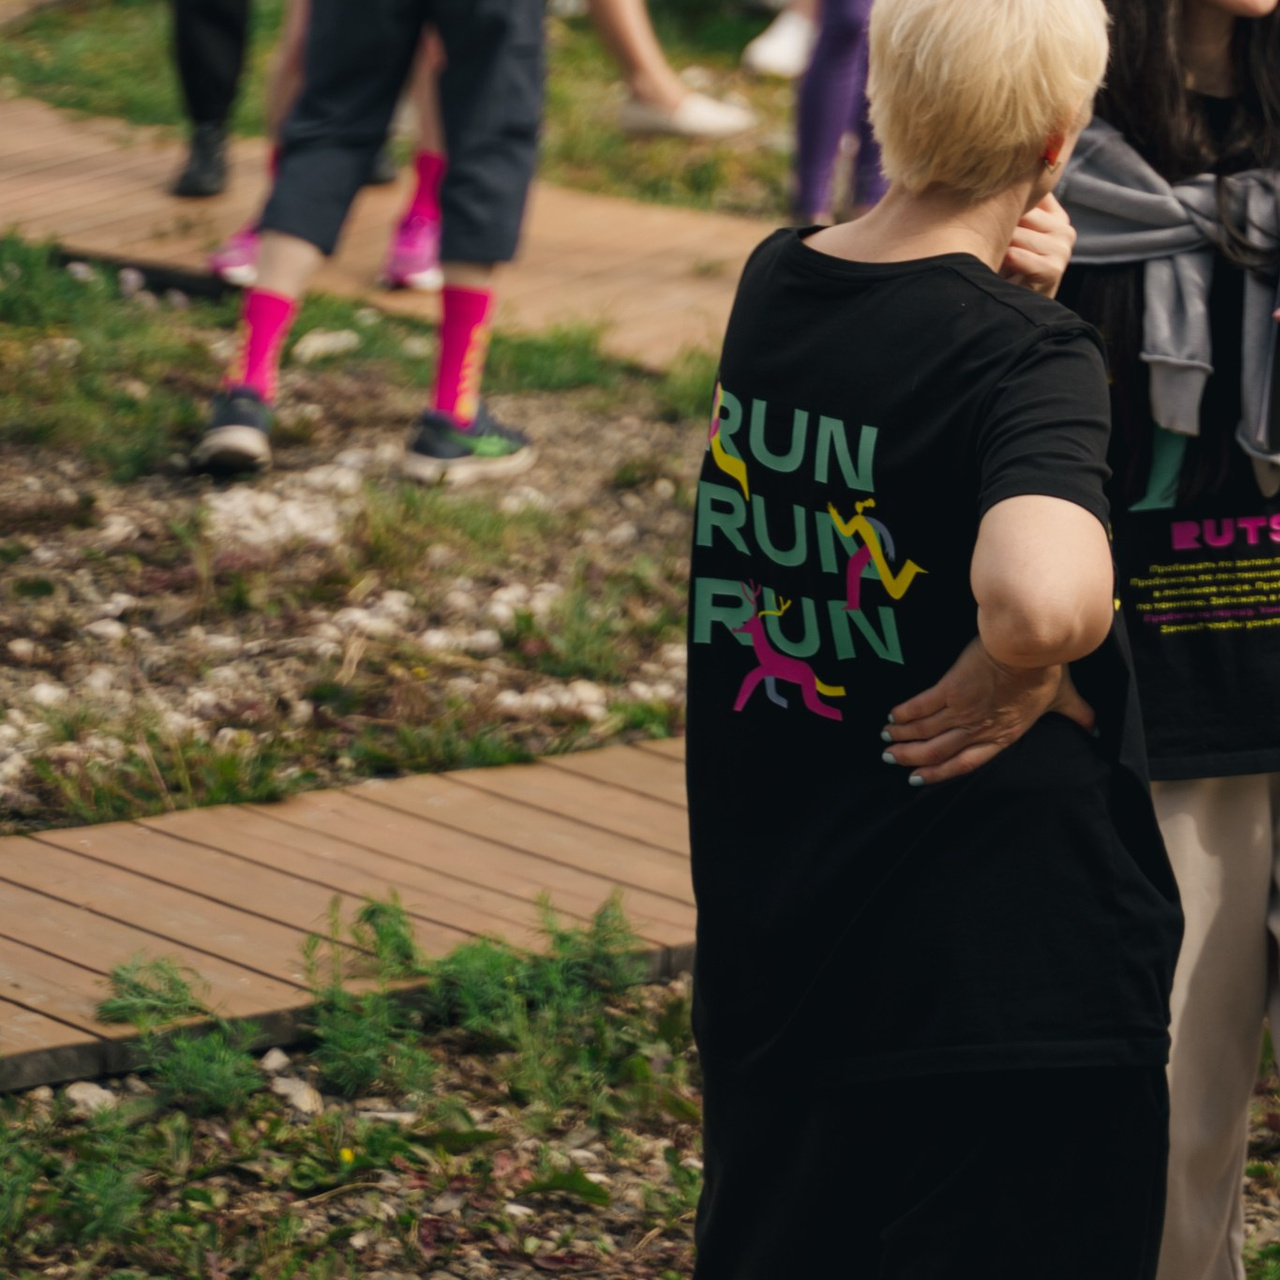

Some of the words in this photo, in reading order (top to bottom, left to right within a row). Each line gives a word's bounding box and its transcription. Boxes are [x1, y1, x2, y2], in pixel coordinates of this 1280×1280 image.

[706, 390, 879, 493] RUN
[696, 480, 883, 580] RUN
[693, 577, 905, 665] RUN
